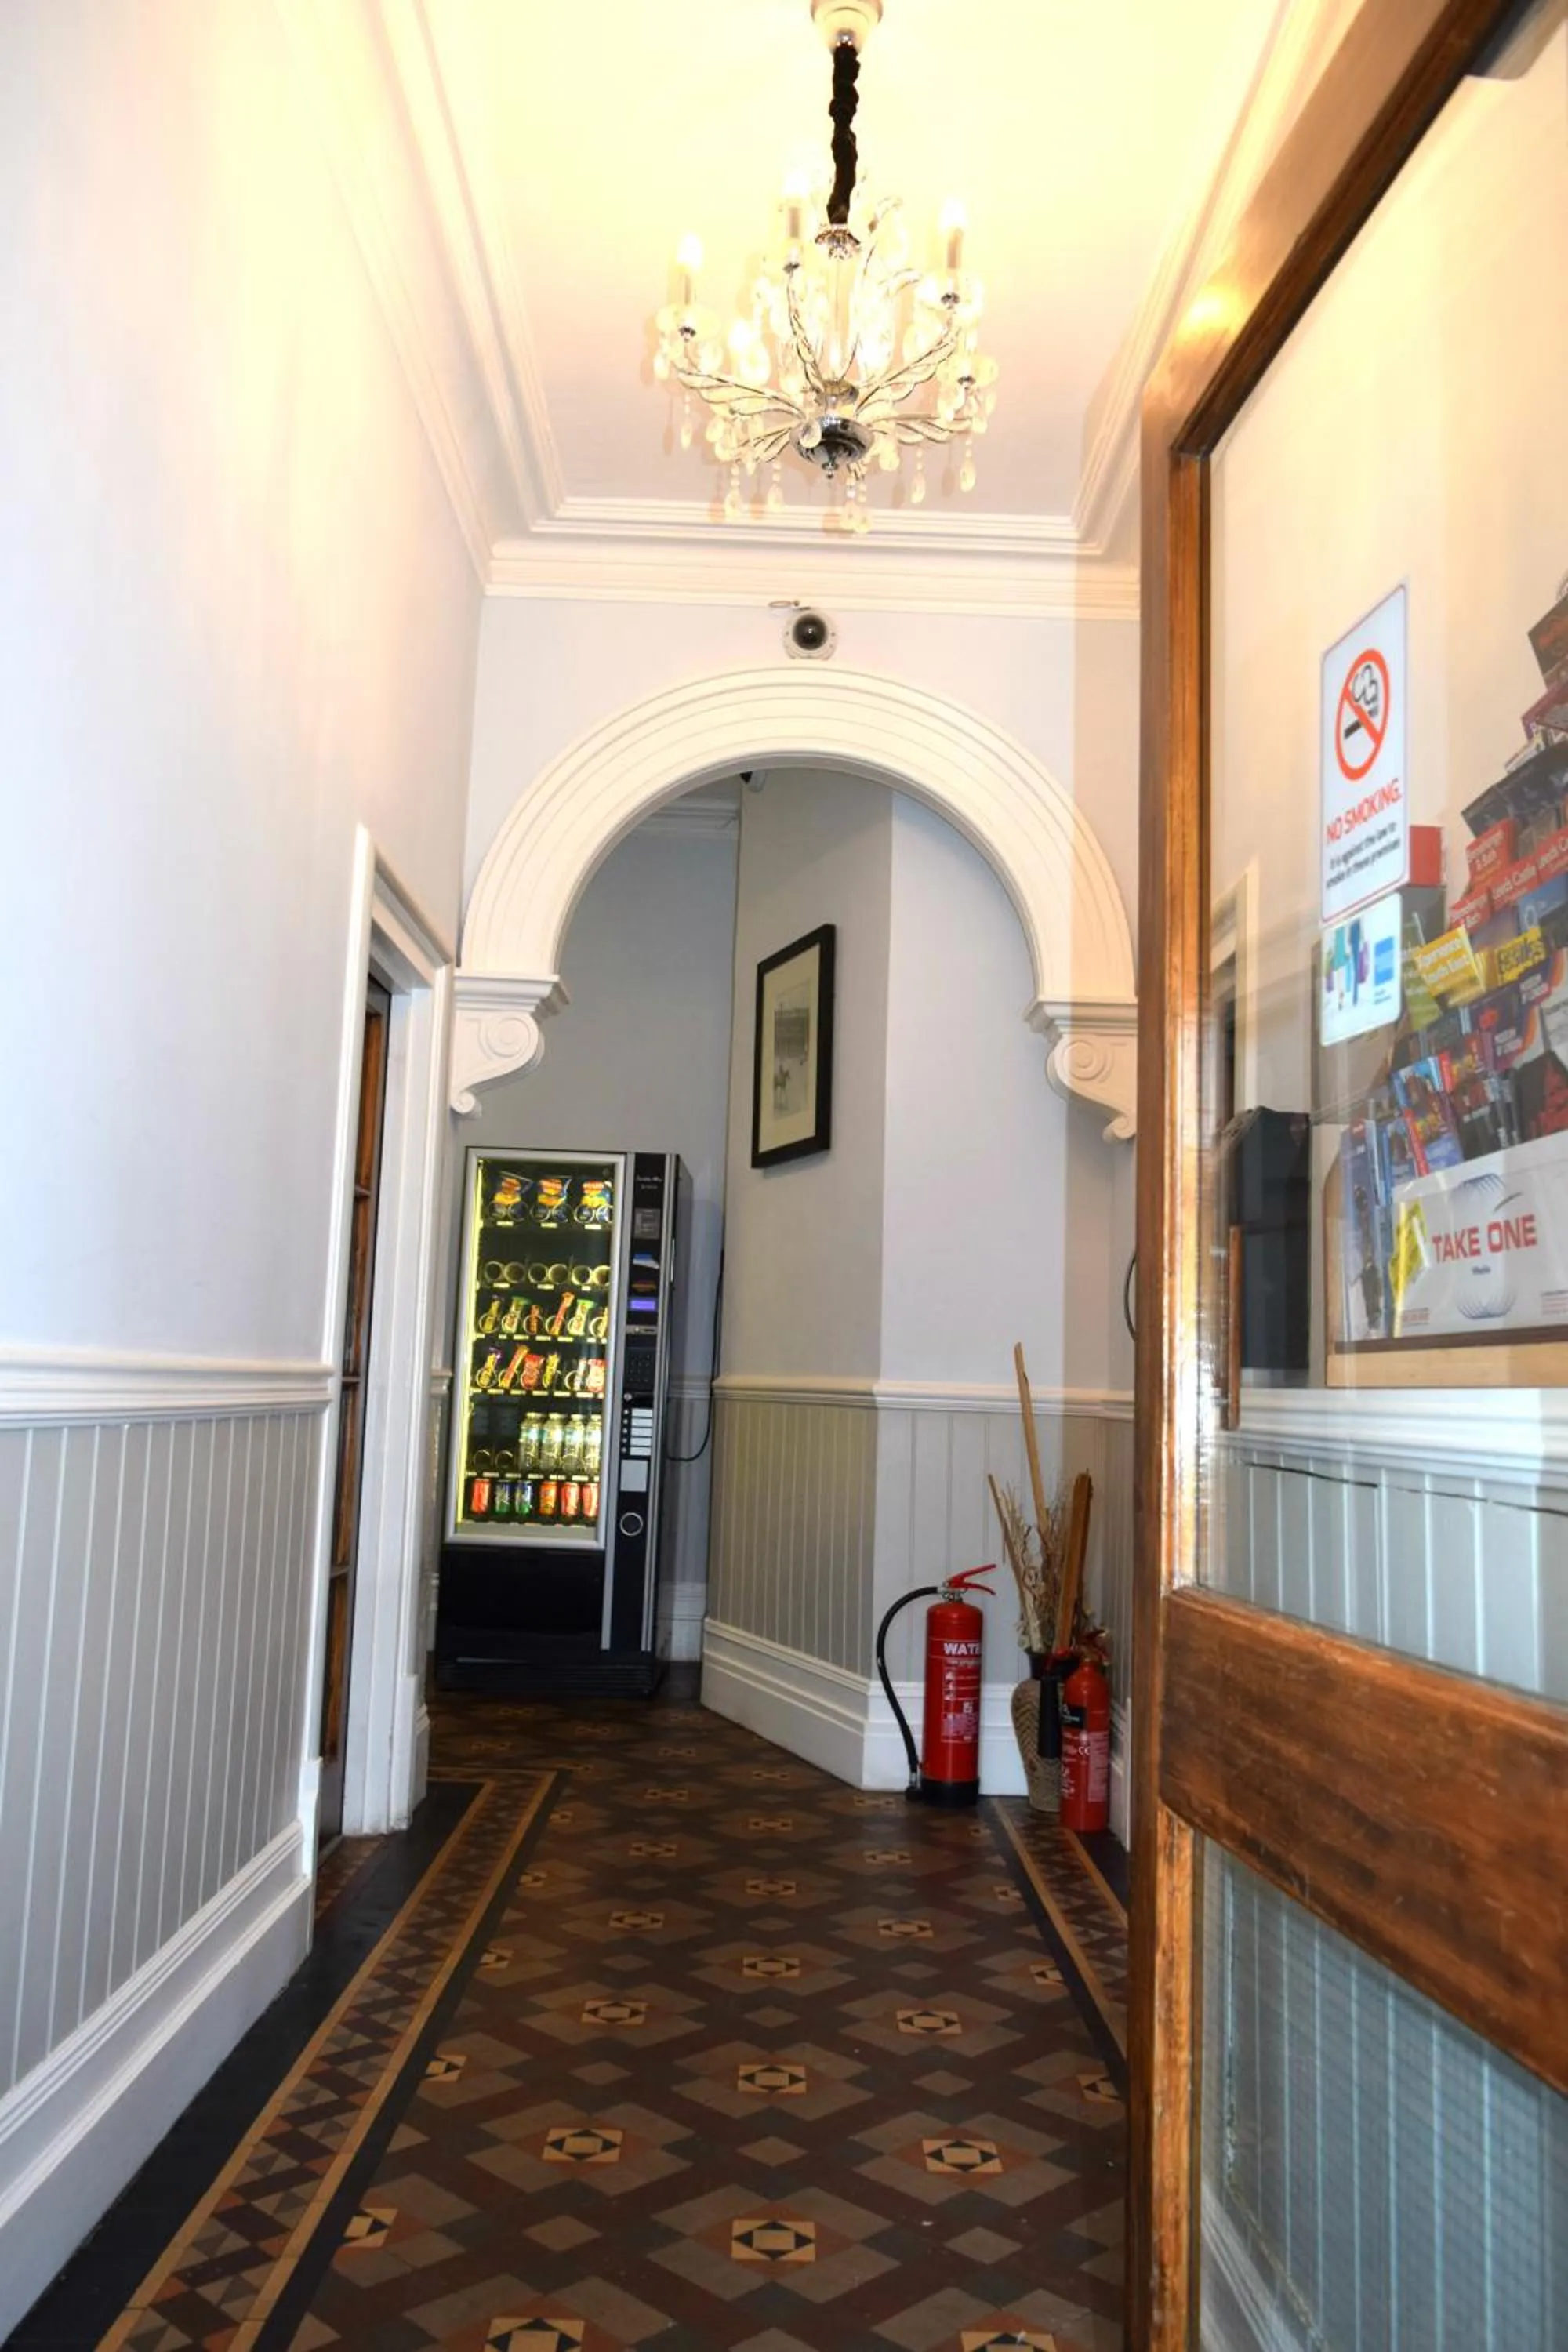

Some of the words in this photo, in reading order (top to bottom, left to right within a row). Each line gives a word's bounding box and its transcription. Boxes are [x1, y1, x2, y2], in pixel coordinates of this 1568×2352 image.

[1327, 816, 1343, 844] NO
[1345, 779, 1402, 834] SMOKING
[1432, 1226, 1482, 1264] TAKE
[1487, 1214, 1537, 1253] ONE
[943, 1642, 980, 1655] WATE
